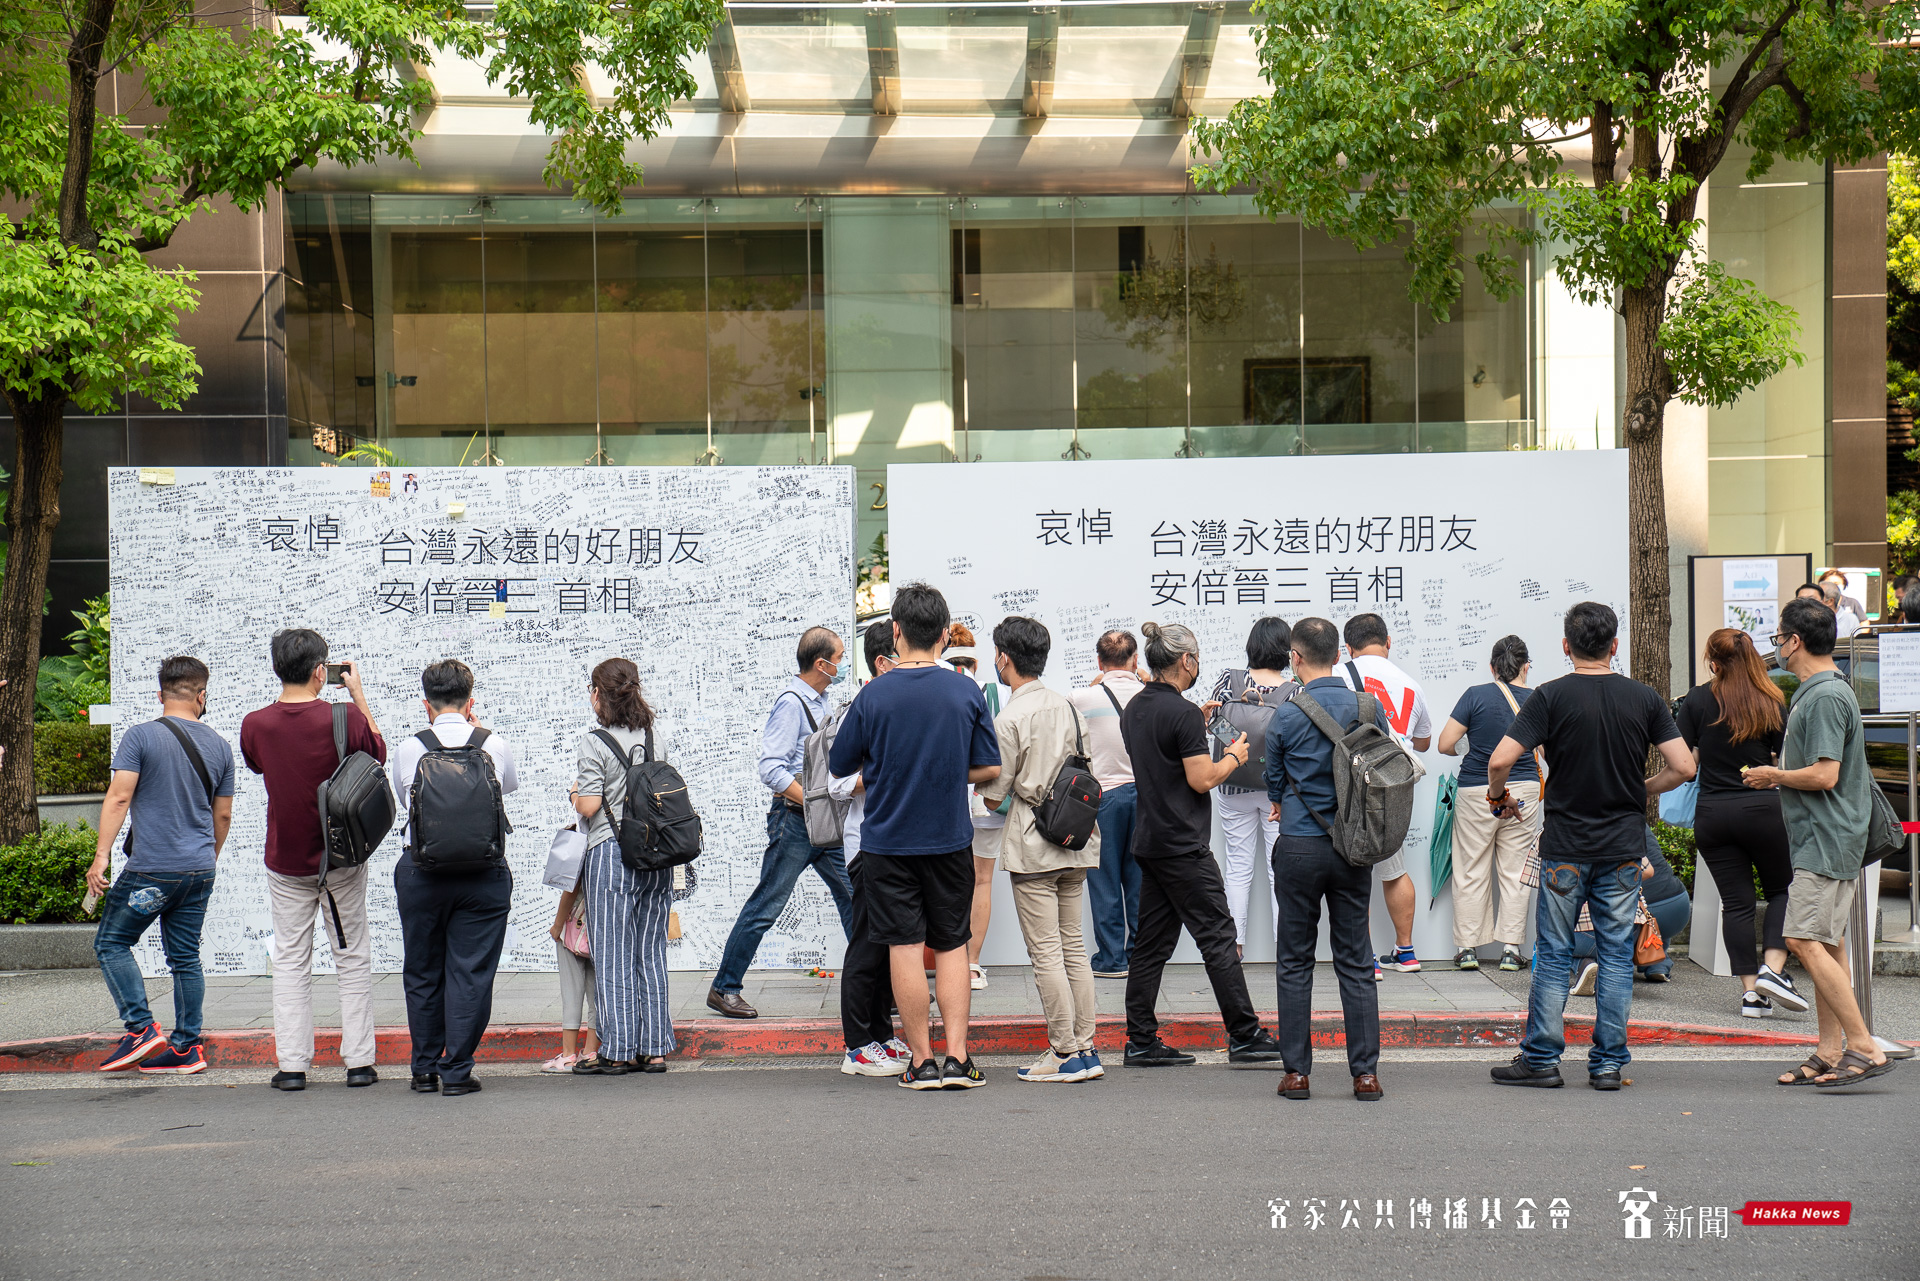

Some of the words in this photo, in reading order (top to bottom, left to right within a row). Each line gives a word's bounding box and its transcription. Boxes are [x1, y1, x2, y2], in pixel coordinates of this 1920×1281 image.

[870, 482, 888, 511] 2
[262, 515, 341, 552] 哀悼
[1035, 508, 1113, 546] 哀悼
[1150, 514, 1478, 558] 台灣永遠的好朋友
[379, 527, 704, 566] 台灣永遠的好朋友
[378, 577, 540, 615] 安倍晉三
[554, 577, 631, 614] 首相
[1150, 567, 1311, 607] 安倍晉三
[1326, 565, 1404, 604] 首相
[502, 618, 563, 632] 就像家人一樣
